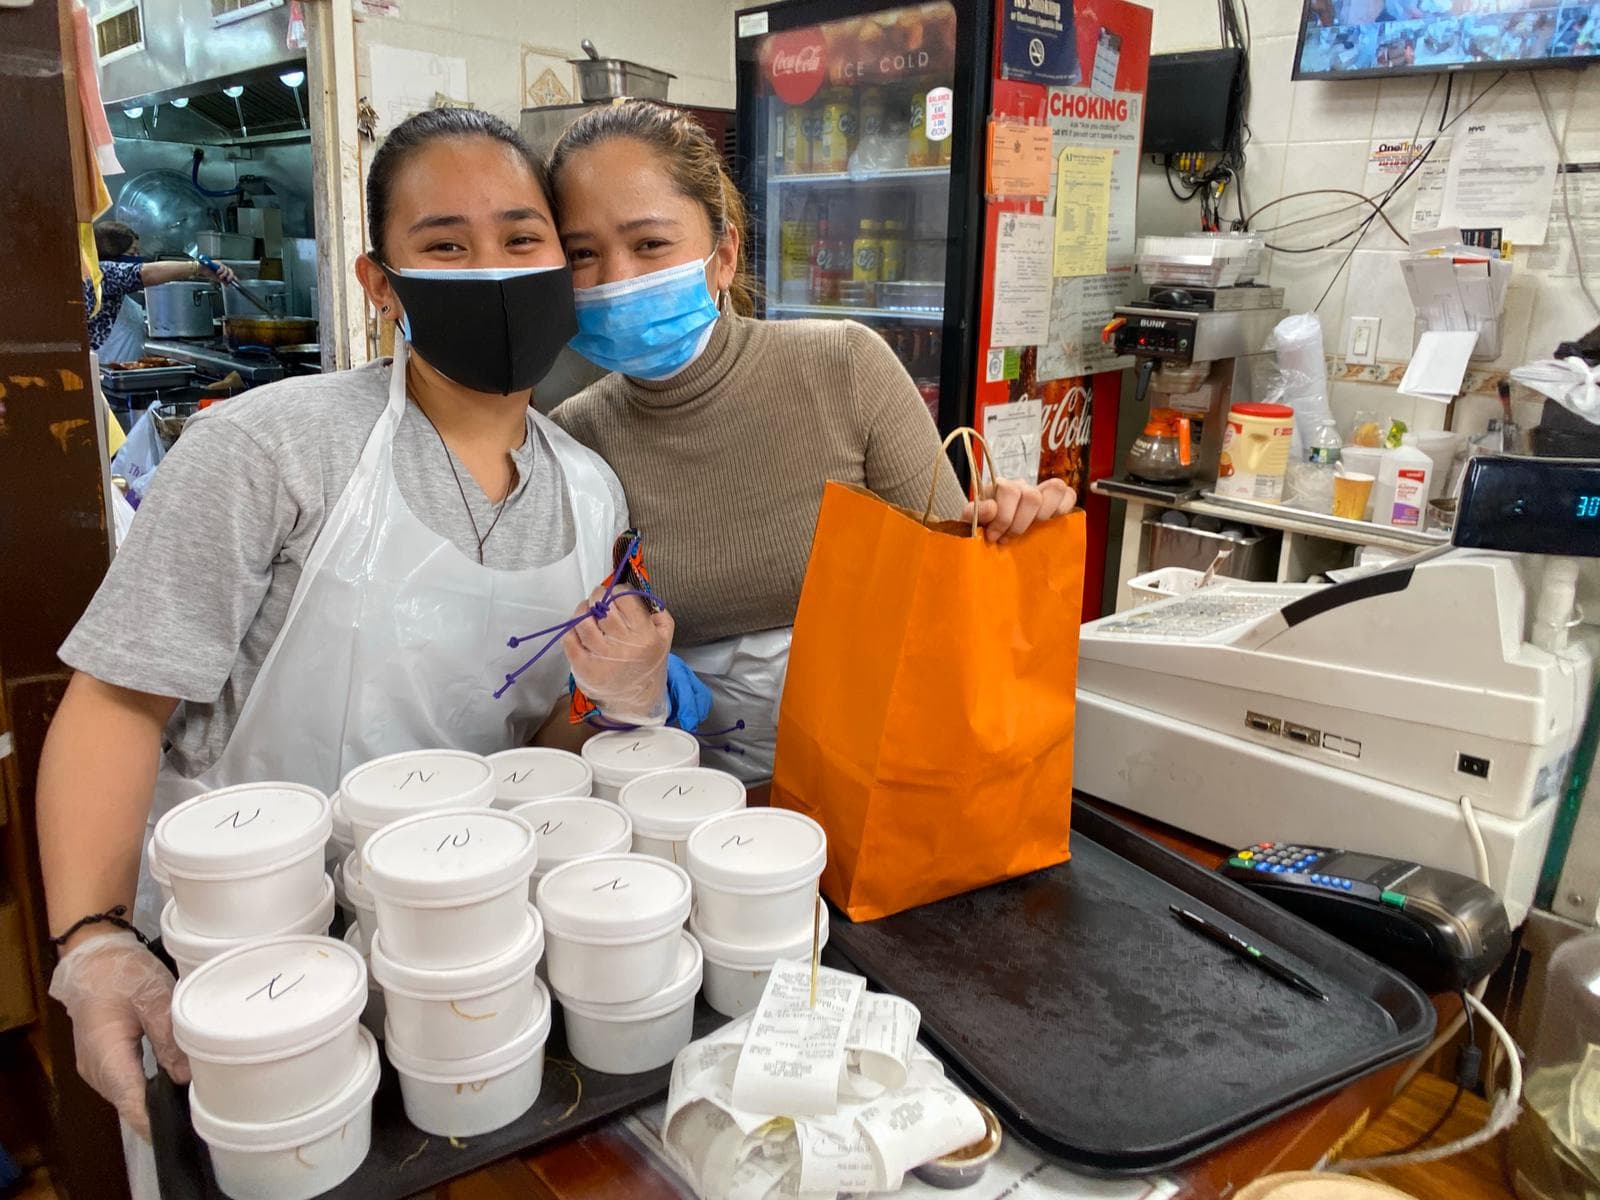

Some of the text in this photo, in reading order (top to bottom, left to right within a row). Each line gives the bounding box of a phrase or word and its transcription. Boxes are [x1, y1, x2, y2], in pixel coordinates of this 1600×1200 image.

[773, 46, 823, 77] Coca-Cola
[838, 52, 929, 78] ICE COLD
[1050, 92, 1128, 121] CHOKING
[1140, 319, 1166, 328] BUNN
